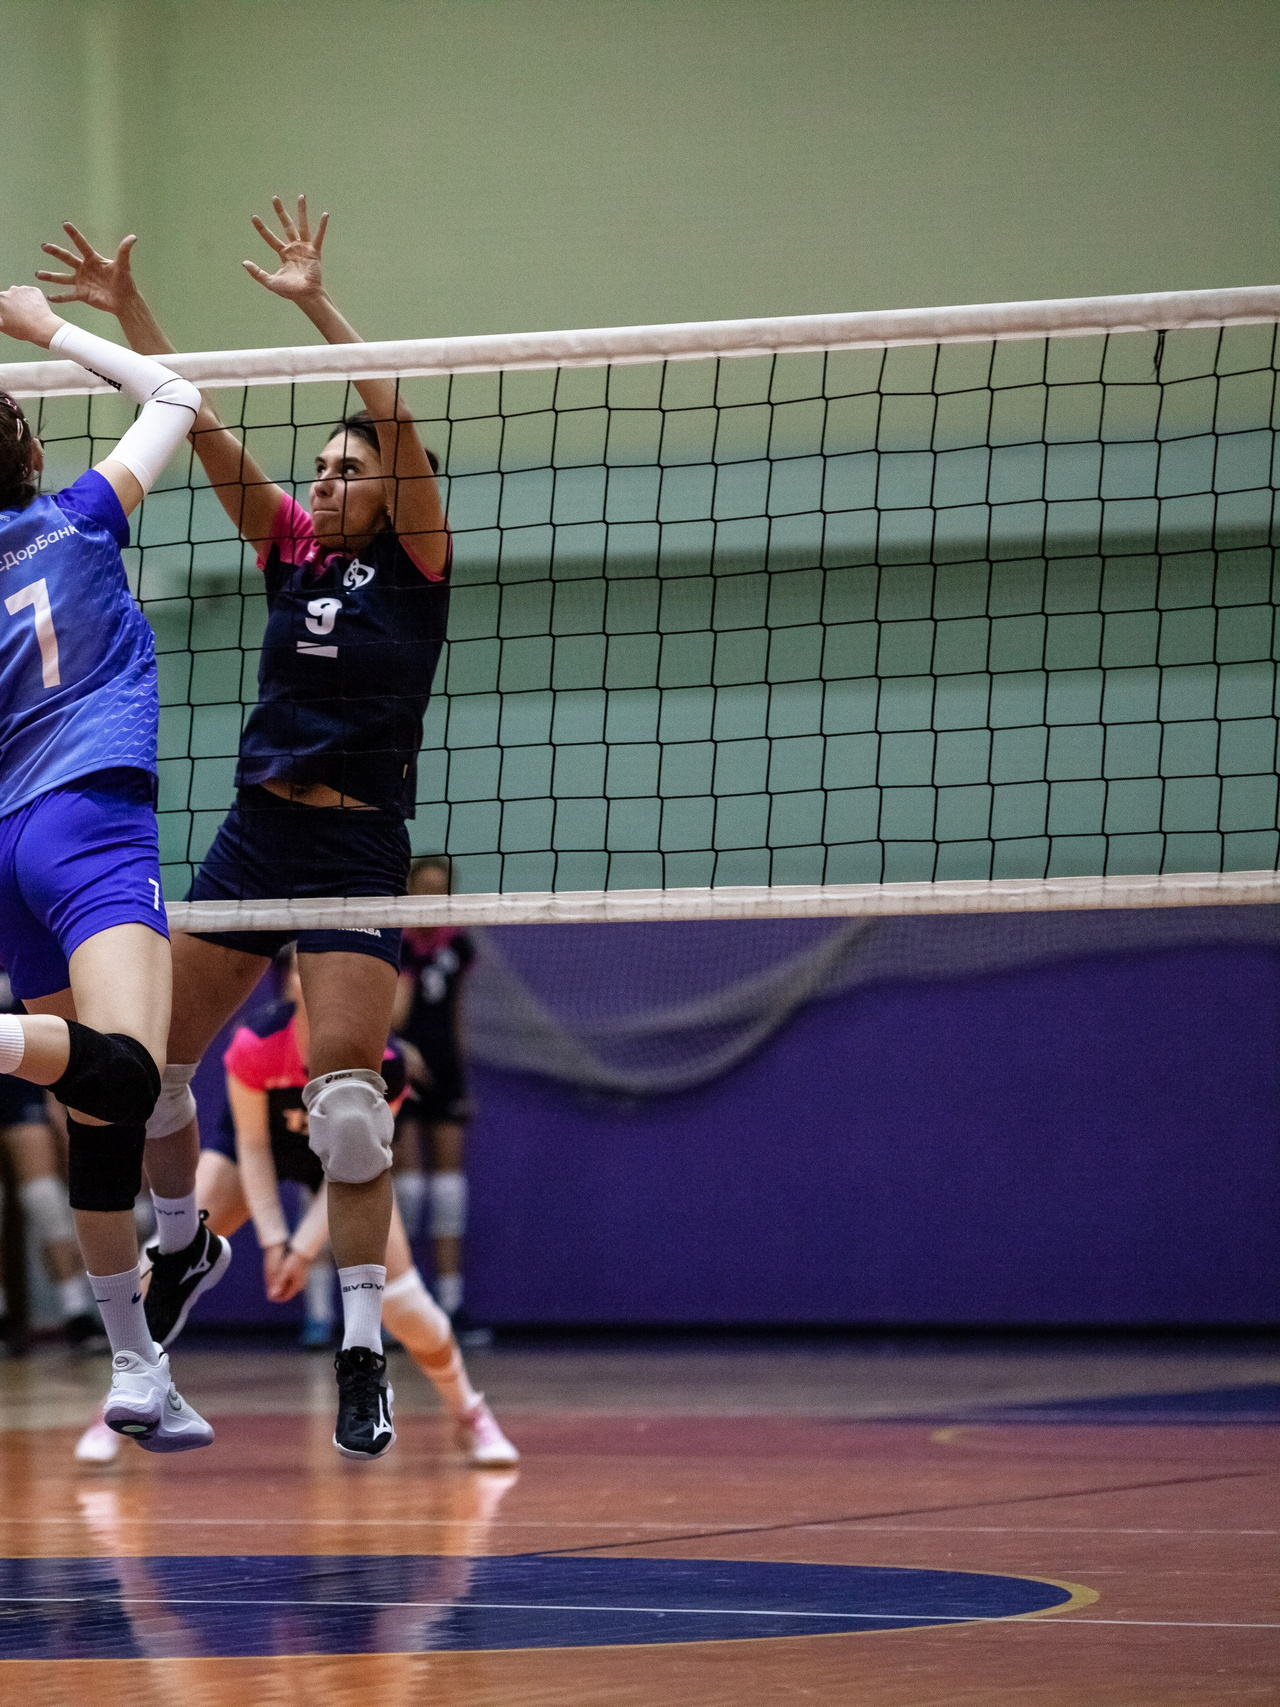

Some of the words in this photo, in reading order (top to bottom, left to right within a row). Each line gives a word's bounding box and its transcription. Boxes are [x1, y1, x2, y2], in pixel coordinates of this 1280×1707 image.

[4, 577, 61, 689] 7
[304, 597, 343, 635] 9
[148, 877, 160, 911] 7
